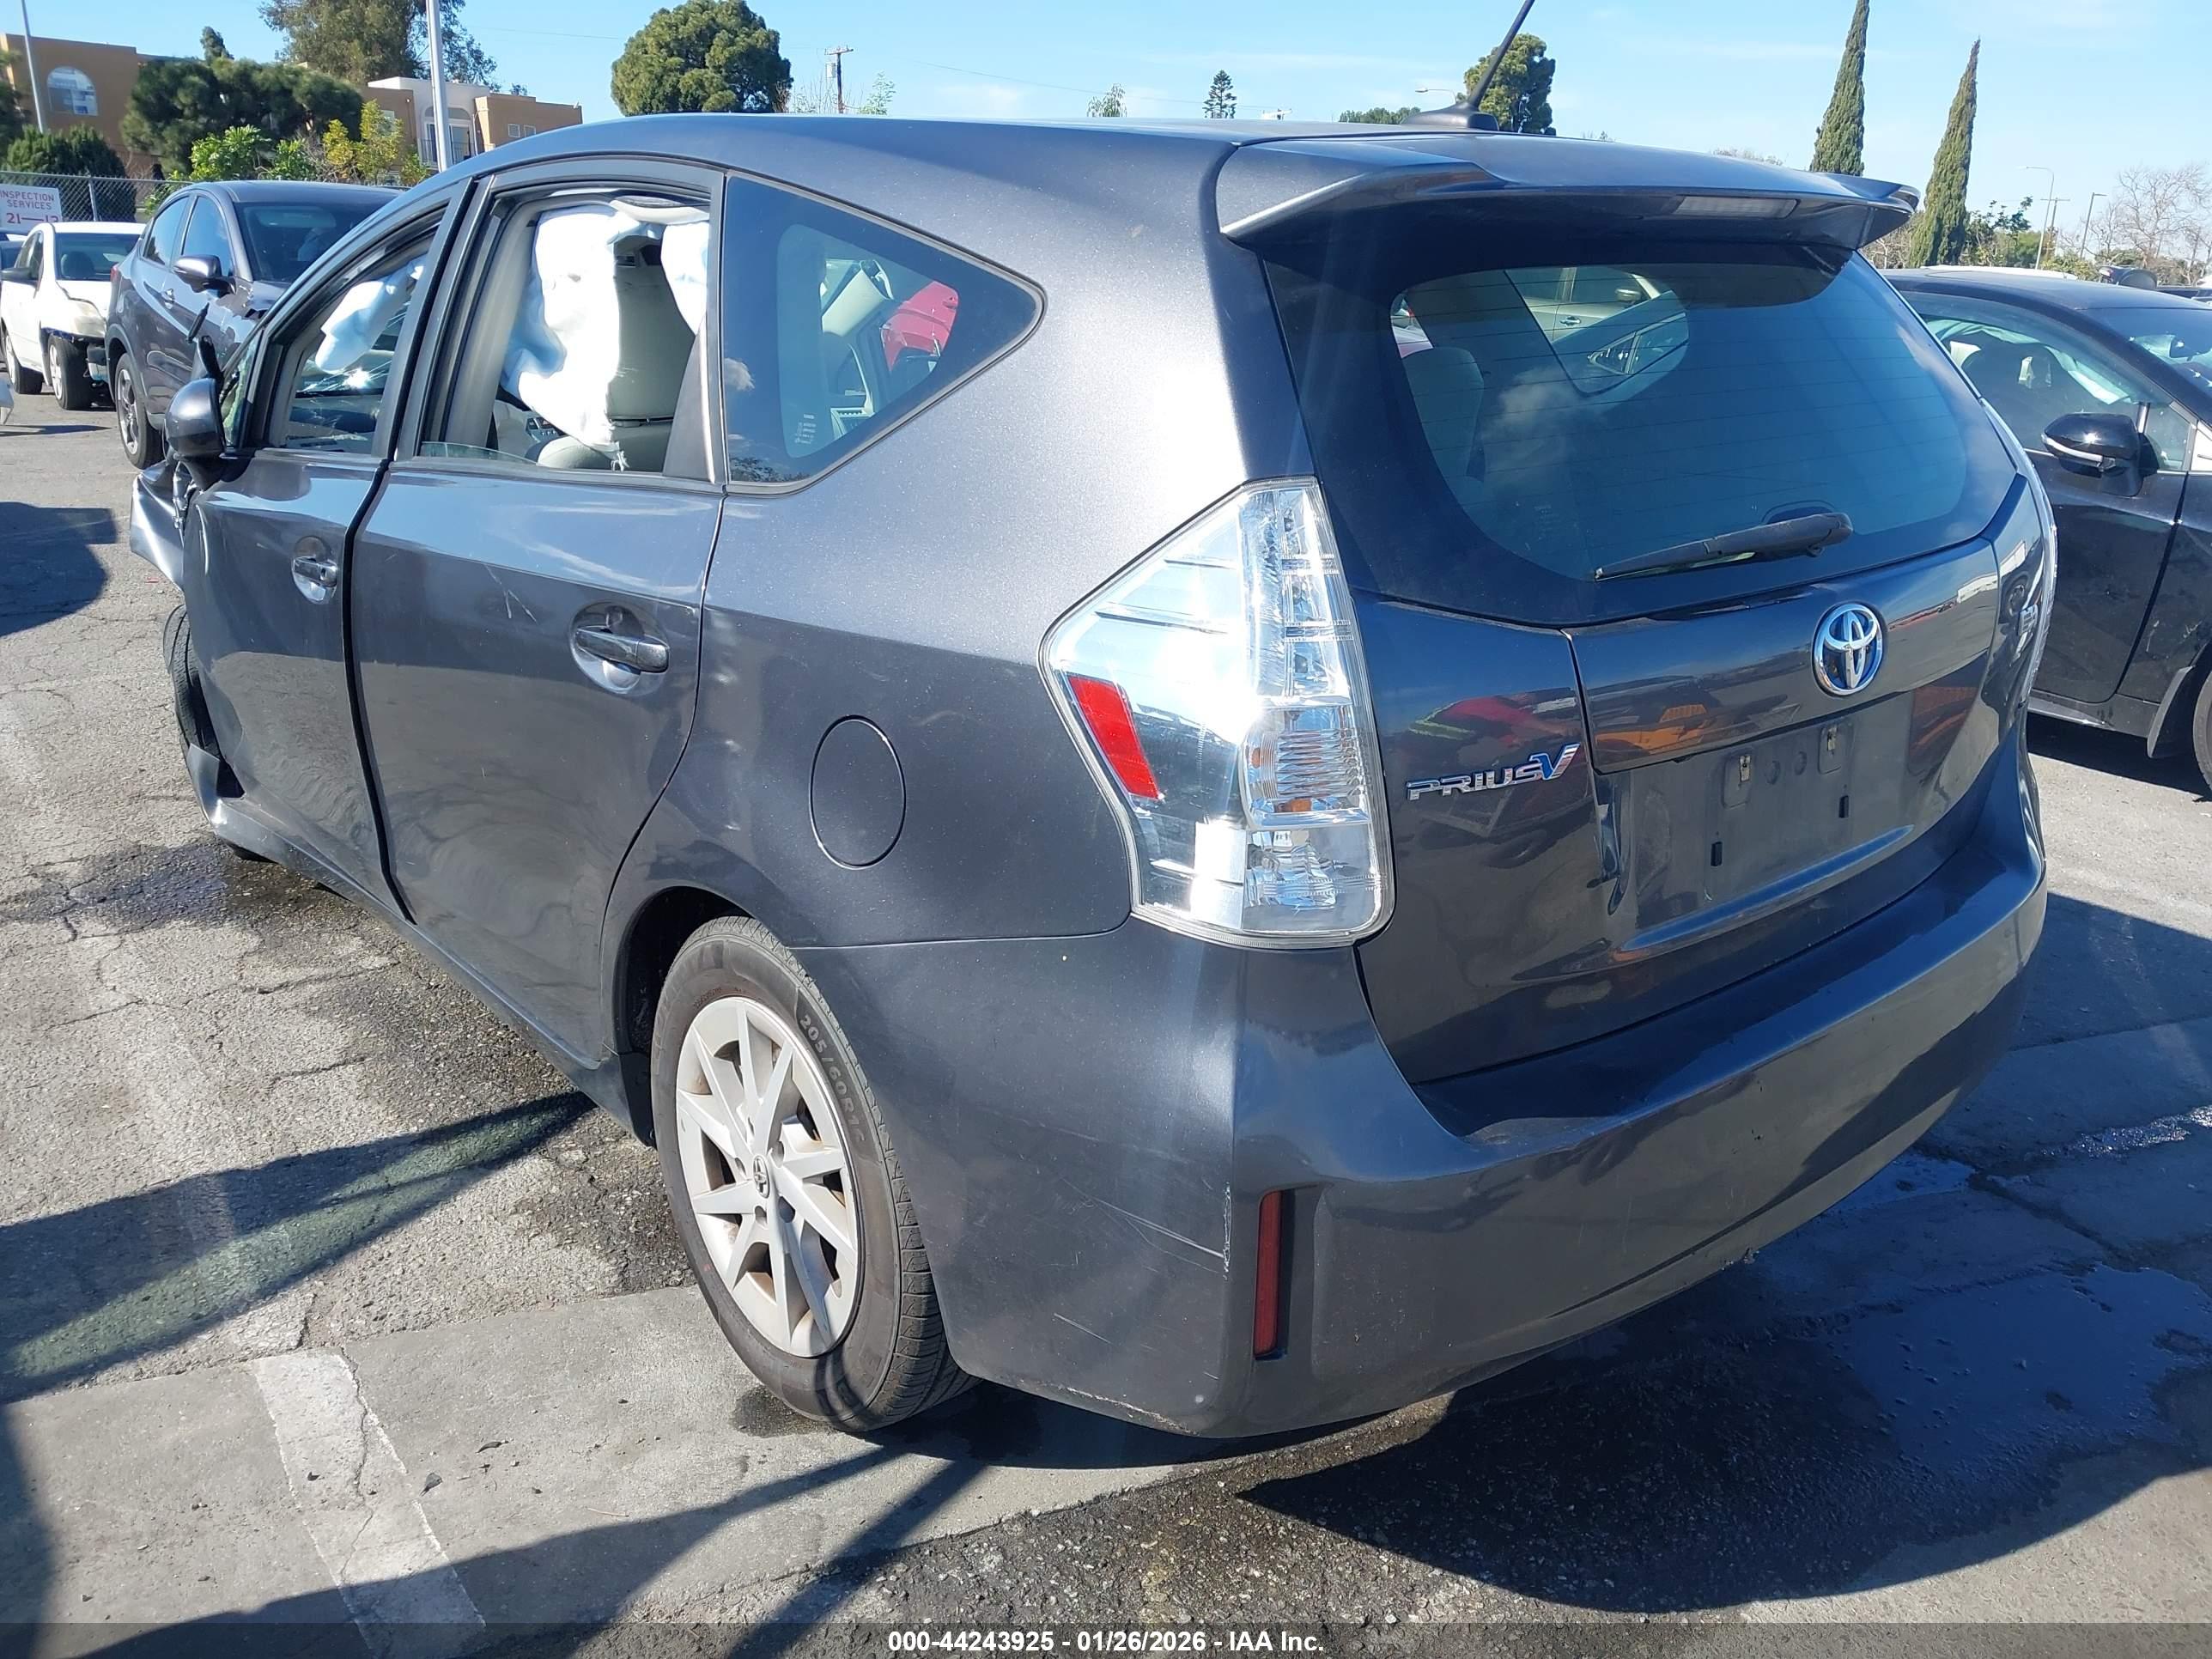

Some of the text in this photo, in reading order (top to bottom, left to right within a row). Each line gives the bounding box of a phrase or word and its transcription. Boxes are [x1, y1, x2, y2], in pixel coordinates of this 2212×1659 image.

[0, 190, 54, 201] INSPECTION
[7, 199, 52, 210] SERVICES
[1405, 760, 1542, 801] PRIUS
